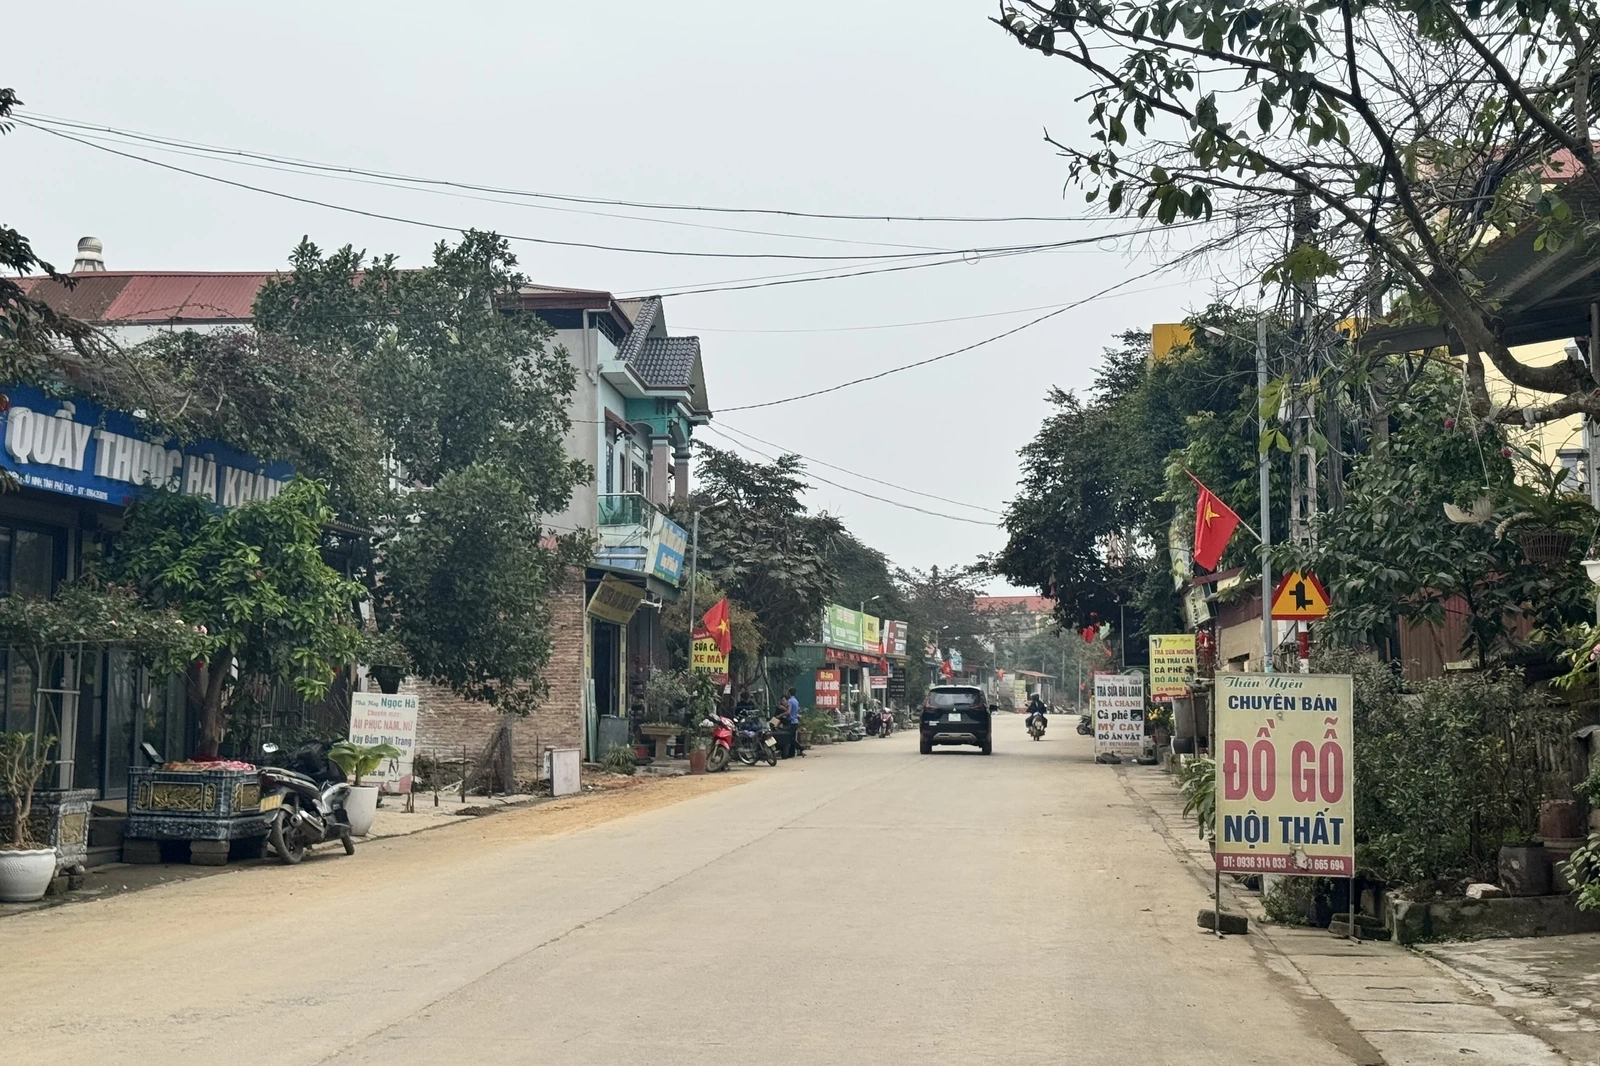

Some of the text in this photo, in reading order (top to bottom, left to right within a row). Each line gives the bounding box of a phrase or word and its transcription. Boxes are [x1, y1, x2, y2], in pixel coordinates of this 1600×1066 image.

[5, 401, 92, 471] QUẦY
[181, 453, 217, 503] HÀ
[219, 468, 286, 507] KHÁN
[710, 643, 721, 652] CH
[694, 653, 726, 664] XE MÁY
[1223, 676, 1303, 690] Thân Uyên
[1128, 686, 1142, 697] LOAN
[380, 697, 403, 709] Ngọc
[404, 698, 416, 708] Hà
[1228, 693, 1337, 711] CHUYÊN BÁN
[1097, 709, 1128, 721] Cà phê
[364, 719, 382, 732] PHỤC
[1119, 723, 1141, 731] CAY
[352, 734, 364, 744] Váy
[395, 736, 412, 747] Trang
[1223, 717, 1344, 803] ĐỒ GỖ
[1224, 808, 1344, 849] NỘI THẤT
[1223, 856, 1235, 867] ĐT:
[1236, 856, 1255, 868] 0936
[1256, 856, 1271, 868] 314
[1272, 857, 1287, 869] 033
[1314, 858, 1329, 870] 665
[1330, 859, 1345, 871] 694
